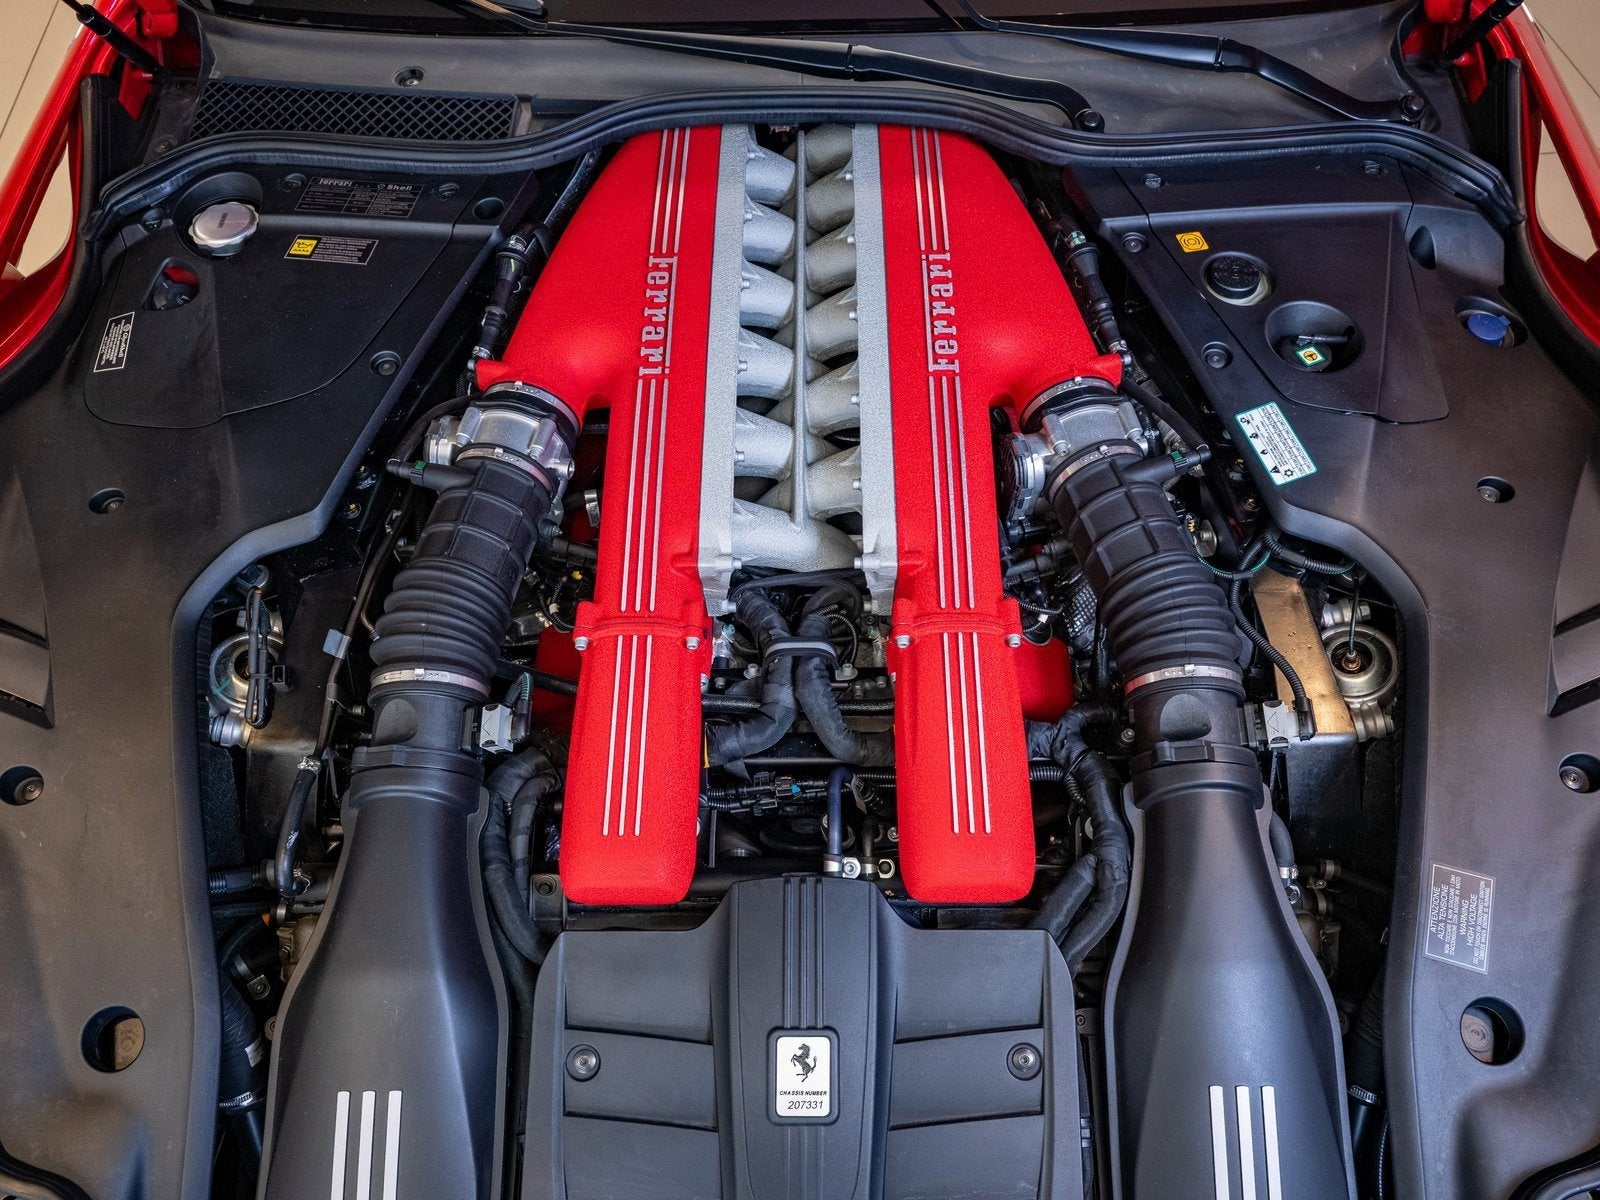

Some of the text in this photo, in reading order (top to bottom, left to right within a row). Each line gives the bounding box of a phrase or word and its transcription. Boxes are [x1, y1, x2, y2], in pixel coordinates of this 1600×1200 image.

[318, 178, 354, 188] Ferrari
[638, 255, 678, 376] Ferrari
[920, 252, 960, 374] Ferrari
[1430, 886, 1440, 933] ATTENZIONE
[1439, 884, 1448, 920] TENSIONE
[1460, 899, 1468, 935] WARNING
[1469, 894, 1477, 925] VOLTAGE
[788, 1100, 823, 1110] 207331
